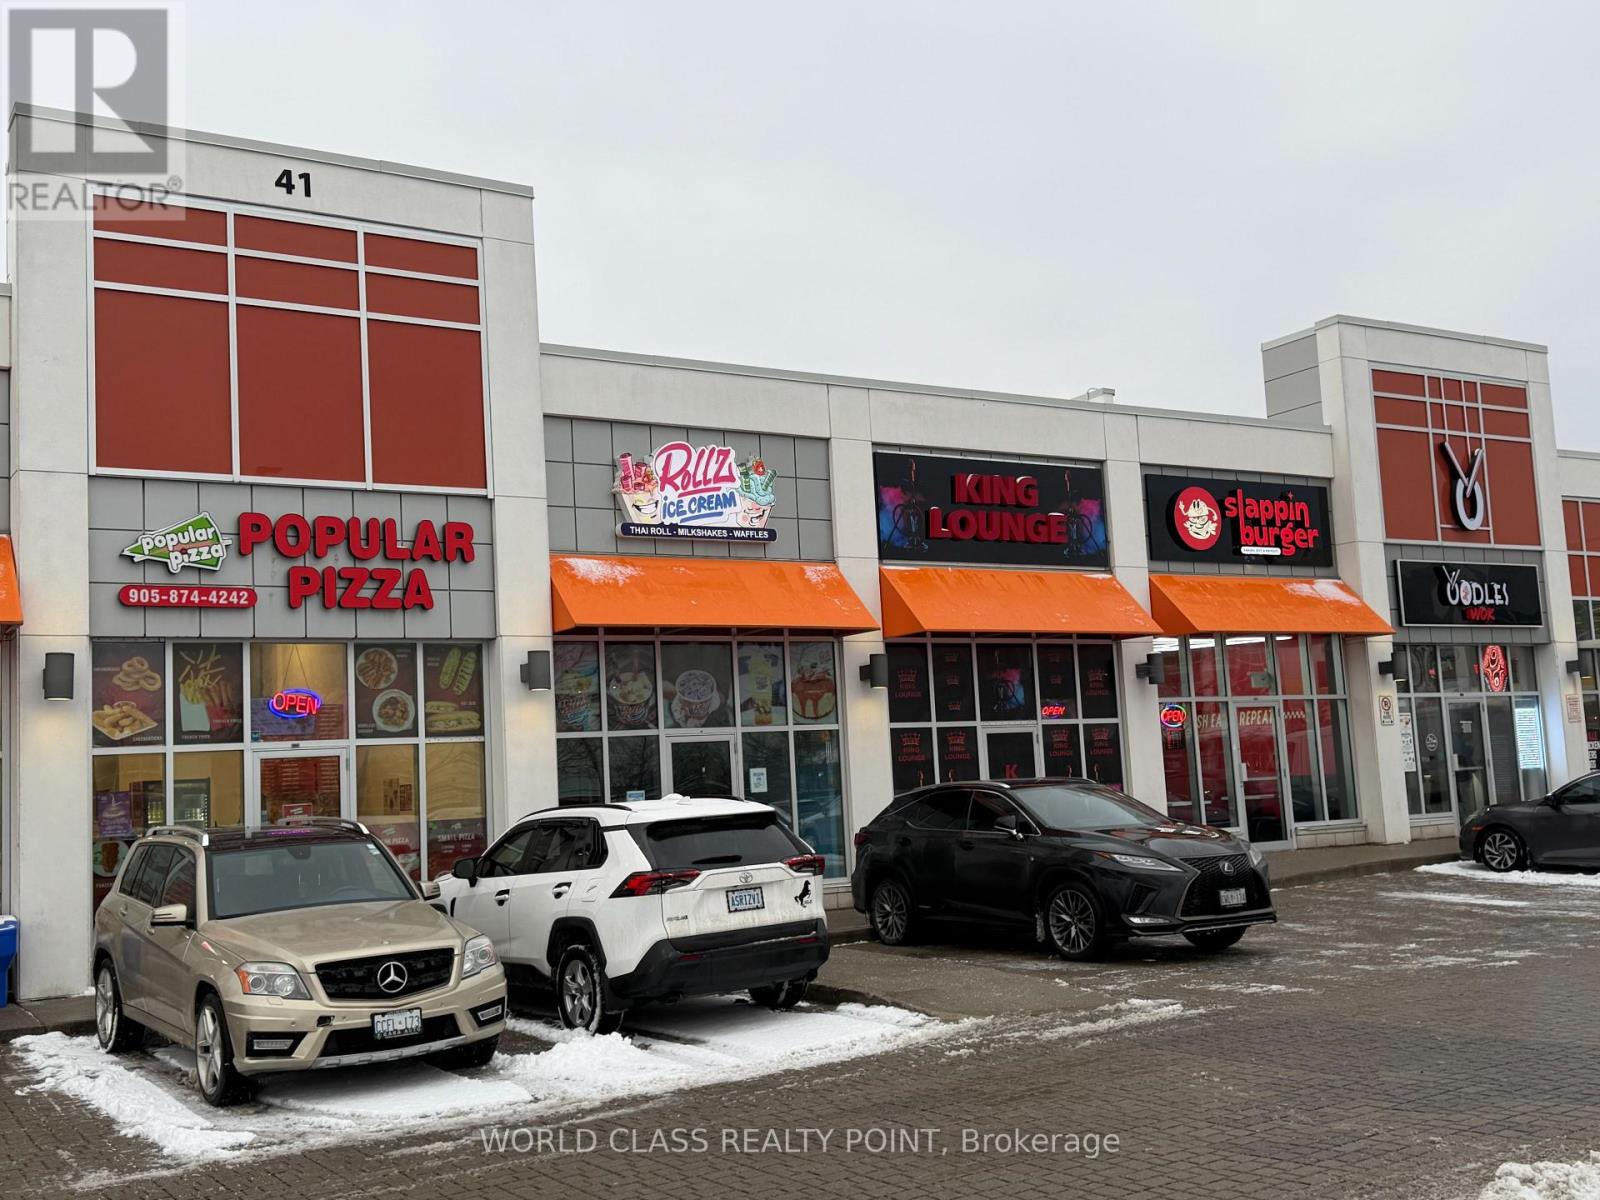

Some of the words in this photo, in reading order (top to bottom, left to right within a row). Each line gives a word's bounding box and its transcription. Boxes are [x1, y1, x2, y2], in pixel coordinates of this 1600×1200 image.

[274, 168, 311, 198] 41
[688, 491, 737, 515] CREAM
[955, 473, 1039, 507] KING
[1224, 488, 1311, 528] slappin
[238, 511, 475, 562] POPULAR
[630, 526, 649, 535] THAI
[651, 528, 672, 536] ROLL
[678, 529, 728, 538] MILKSHAKES
[734, 531, 769, 539] WAFFLES
[927, 506, 1069, 544] LOUNGE
[1241, 522, 1319, 557] burger
[141, 526, 216, 555] popular
[169, 543, 225, 571] pizza
[128, 588, 249, 605] 905-874-4242
[288, 565, 434, 609] PIZZA
[273, 692, 318, 715] OPEN
[1041, 706, 1066, 716] OPEN
[1161, 709, 1185, 723] OPEN
